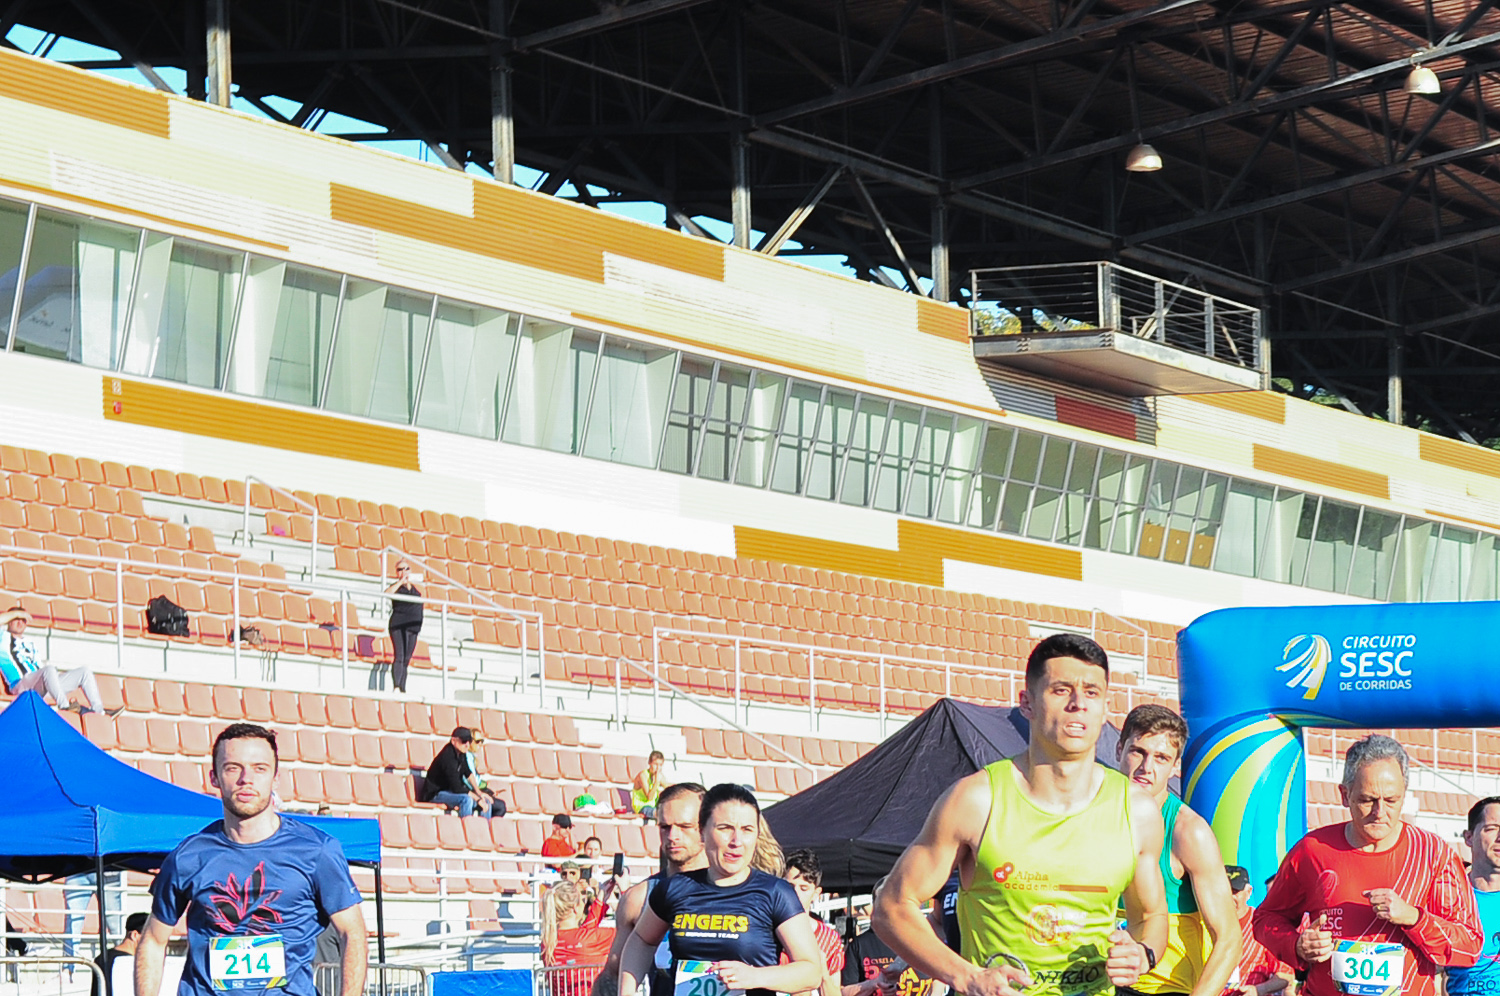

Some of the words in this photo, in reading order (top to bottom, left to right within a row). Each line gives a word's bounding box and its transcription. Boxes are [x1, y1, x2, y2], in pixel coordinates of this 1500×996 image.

[1342, 634, 1417, 649] CIRCUITO
[1339, 651, 1414, 678] SESC
[1339, 681, 1353, 691] DE
[1354, 679, 1412, 691] CORRIDAS
[1014, 871, 1049, 882] Alpha
[1004, 882, 1059, 891] academia
[225, 951, 271, 975] 214
[1343, 957, 1391, 981] 304
